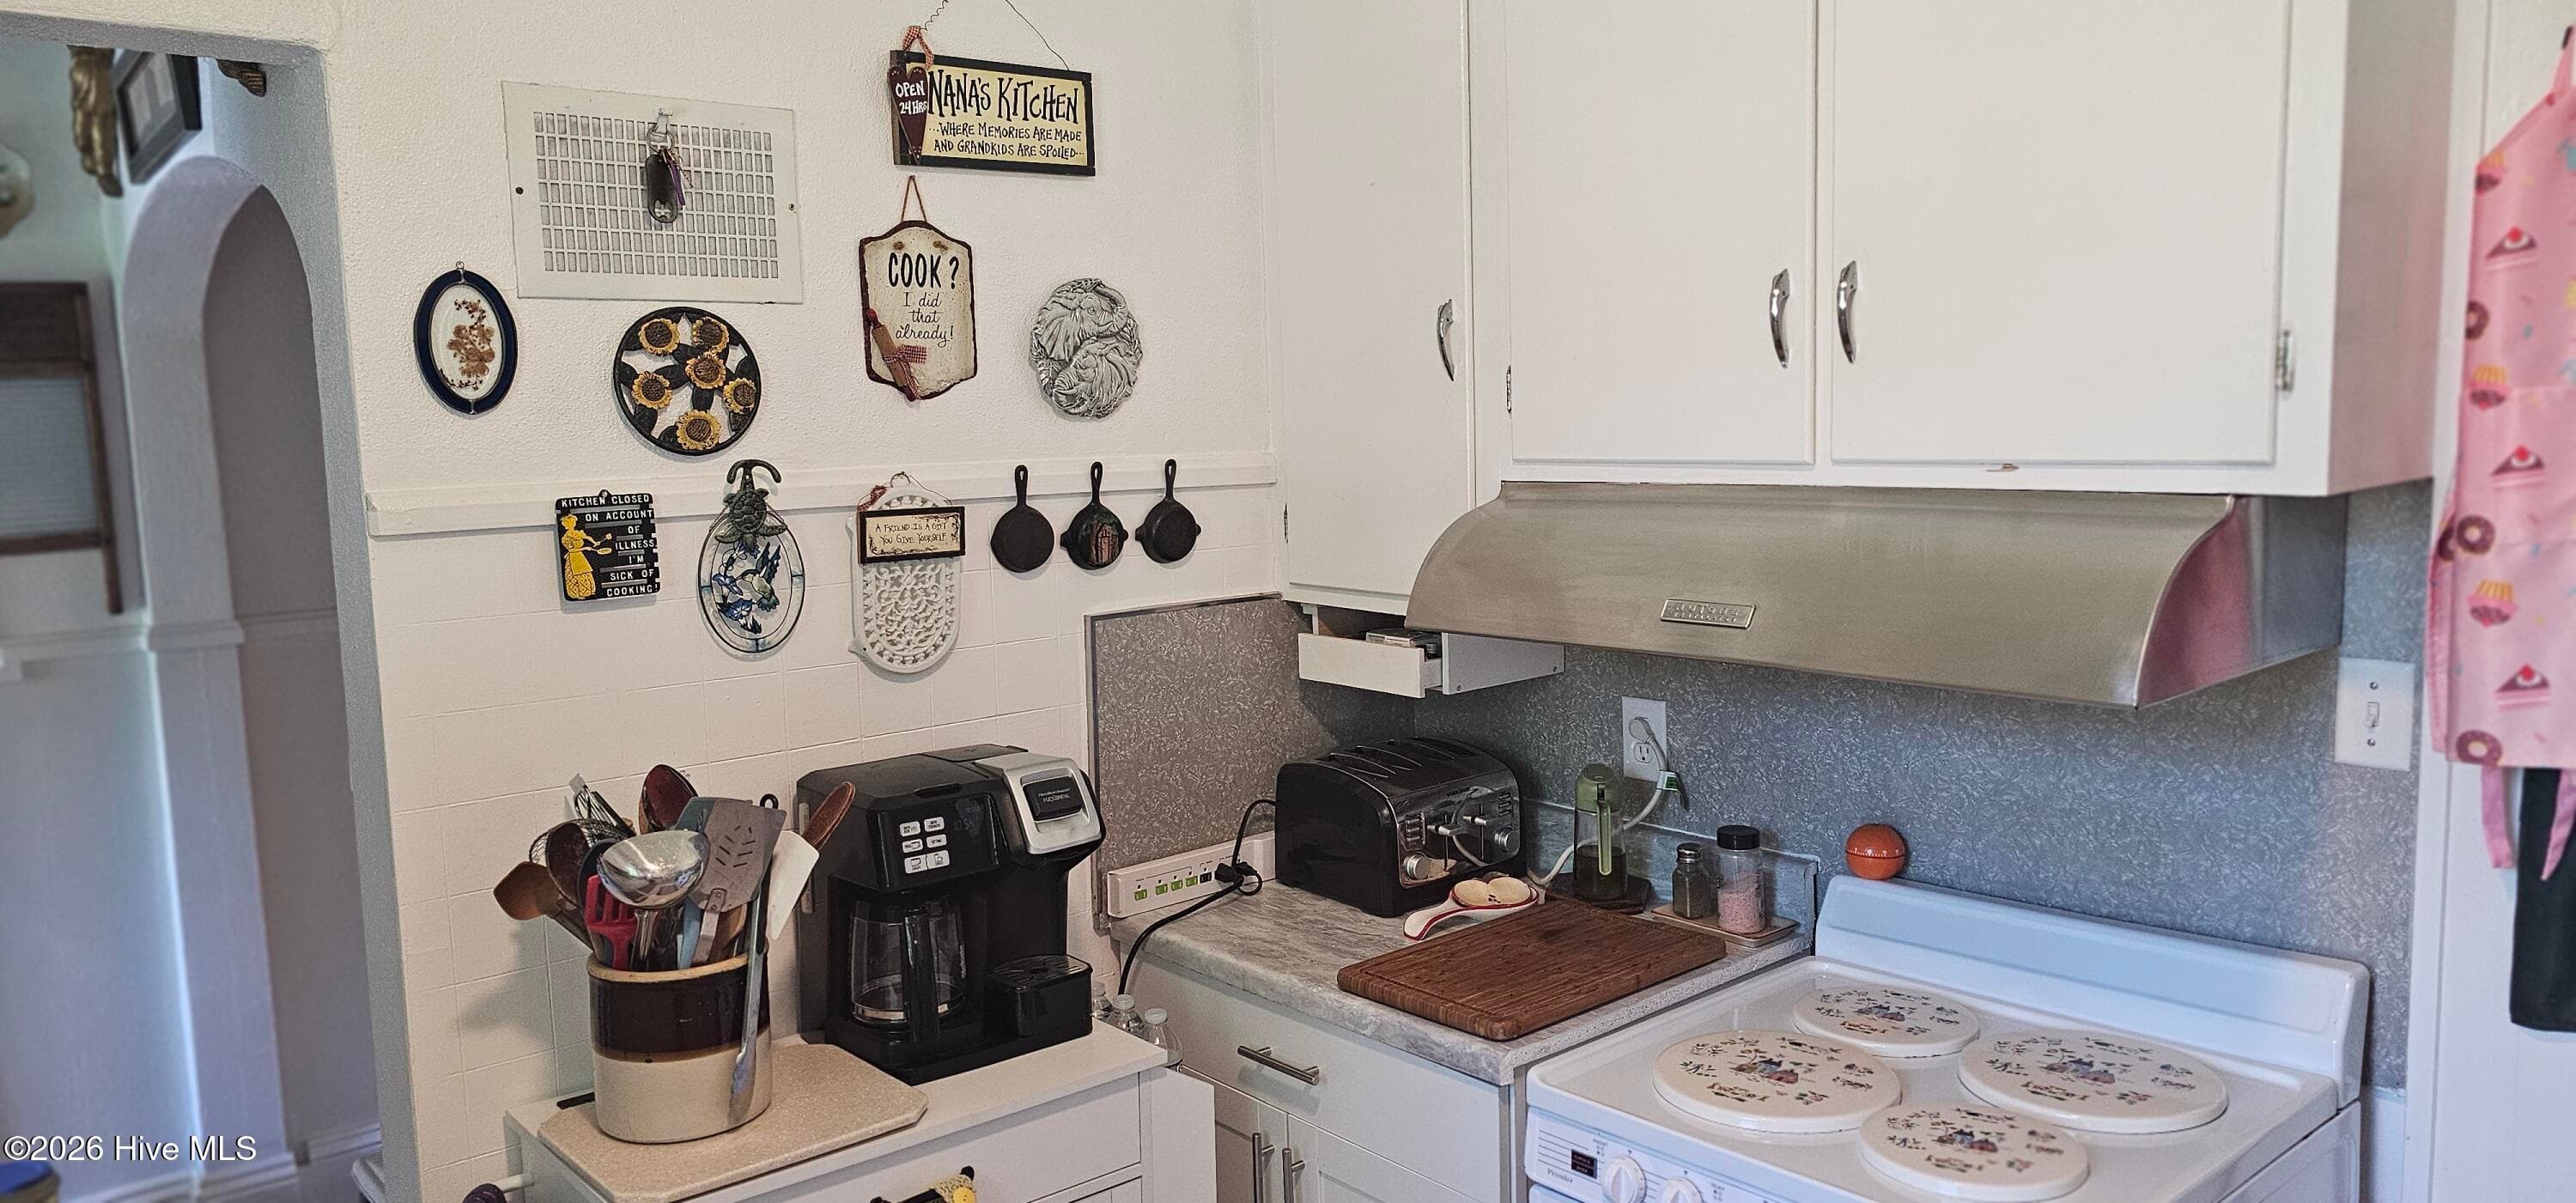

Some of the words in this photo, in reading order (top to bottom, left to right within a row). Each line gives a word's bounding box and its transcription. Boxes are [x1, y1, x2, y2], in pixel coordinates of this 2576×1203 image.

[896, 80, 926, 98] OPEN
[927, 70, 991, 117] NANA'S
[997, 77, 1079, 125] KITCHEN
[978, 123, 1030, 139] MEMORIES
[1033, 128, 1053, 140] ARE
[1054, 128, 1082, 143] MADE
[933, 139, 954, 152] AND
[957, 139, 1014, 155] GRANDKIDS
[1017, 143, 1037, 156] ARE
[902, 291, 914, 307] I
[918, 292, 942, 307] did
[908, 307, 945, 324] that
[561, 497, 605, 507] KITCHEN
[611, 495, 650, 505] CLOSED
[585, 513, 598, 522] ON
[605, 509, 653, 520] ACCOUNT
[628, 525, 641, 534] OF
[876, 523, 882, 532] A
[884, 524, 910, 533] FRIEND
[615, 539, 654, 550] ILLNESS
[879, 535, 893, 546] YOU
[896, 533, 914, 544] GIVE
[629, 556, 644, 564] I'M
[610, 570, 634, 581] SICK
[641, 568, 654, 578] OF
